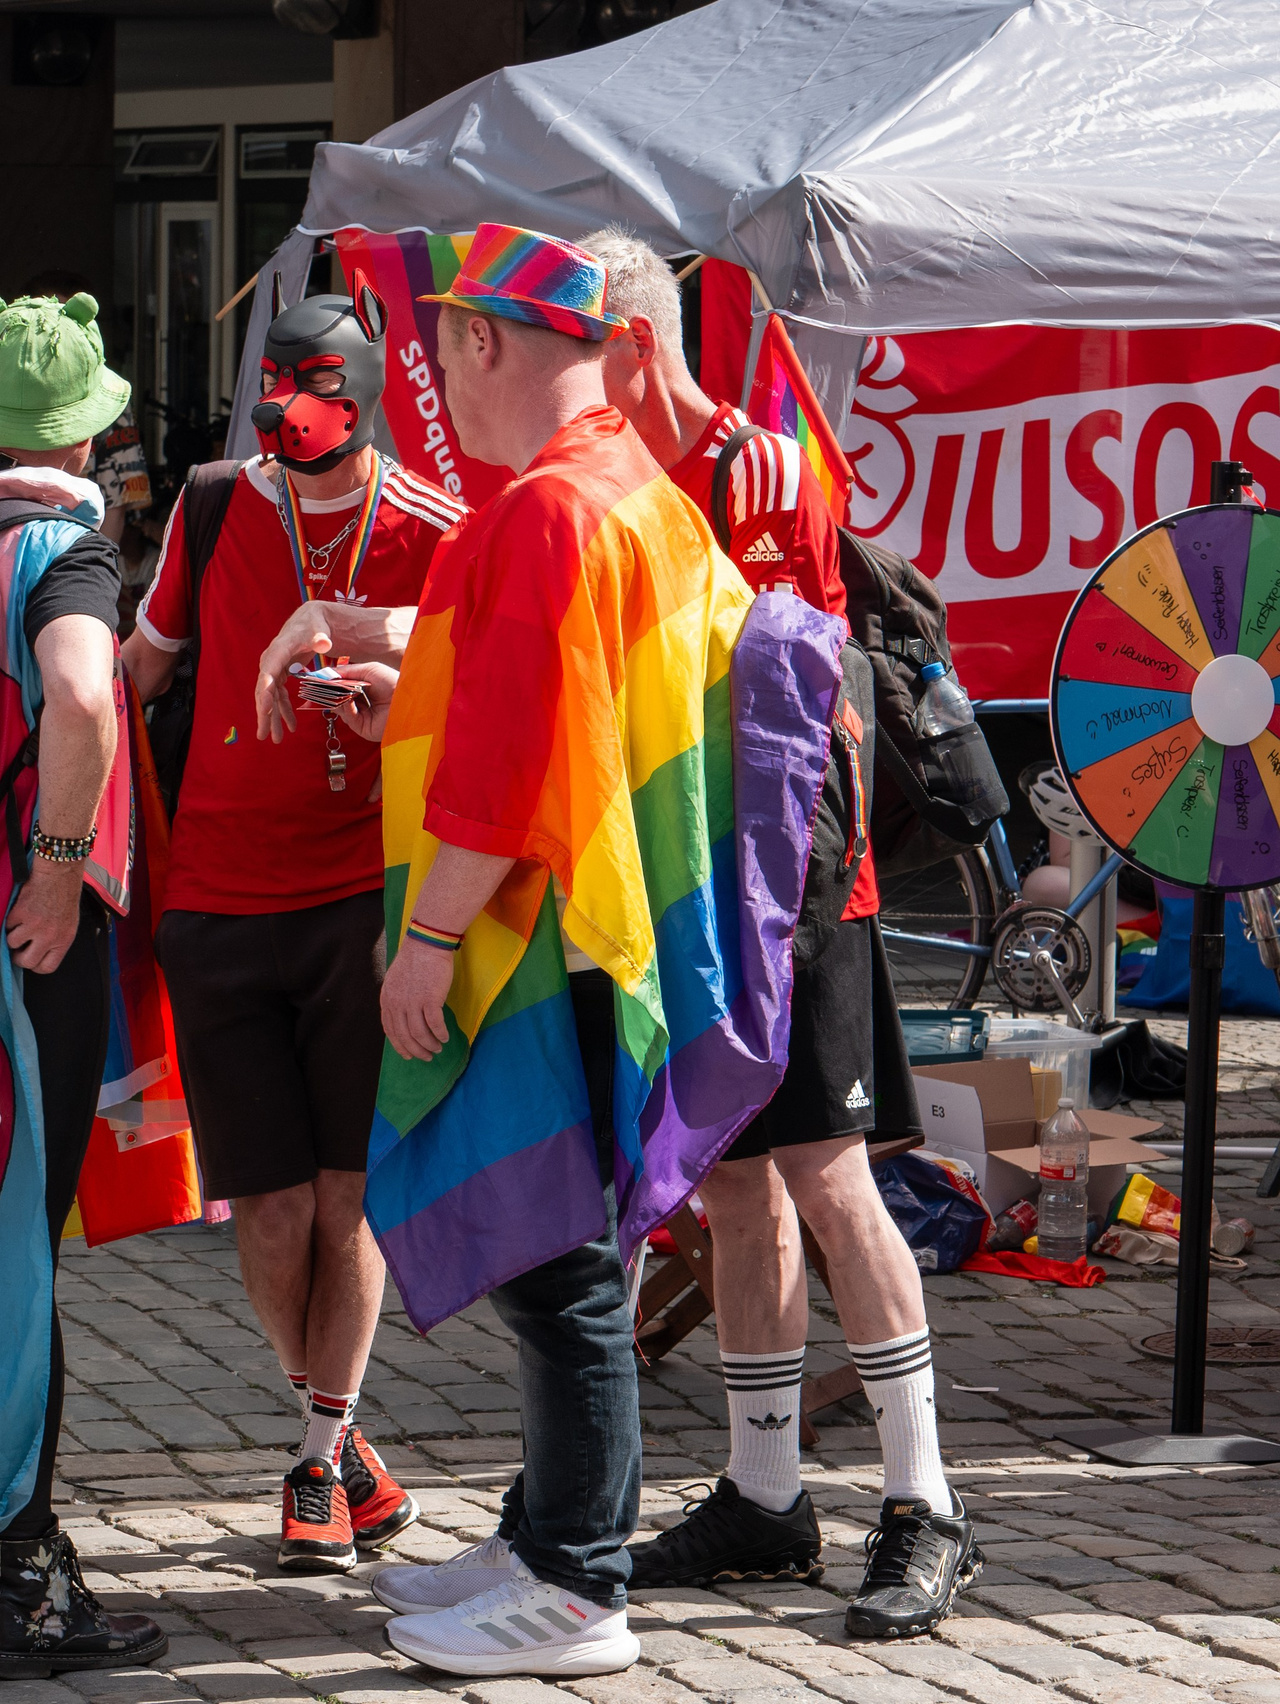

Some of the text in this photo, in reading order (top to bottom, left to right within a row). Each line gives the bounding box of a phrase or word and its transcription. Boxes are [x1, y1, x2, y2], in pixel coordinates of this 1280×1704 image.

[399, 340, 468, 505] SPDque
[910, 385, 1280, 581] JUSOS
[742, 550, 785, 563] adidas
[1151, 582, 1200, 649] Happy Pride!
[1211, 565, 1228, 640] Seifenblasen
[1112, 641, 1178, 681] Gewonnen!
[1101, 699, 1172, 731] Nochmal
[1131, 736, 1188, 785] Süßes
[1232, 759, 1250, 831] Seifenblasen
[845, 1097, 870, 1108] adidas
[931, 1104, 946, 1118] E3
[893, 1505, 915, 1515] NIKE
